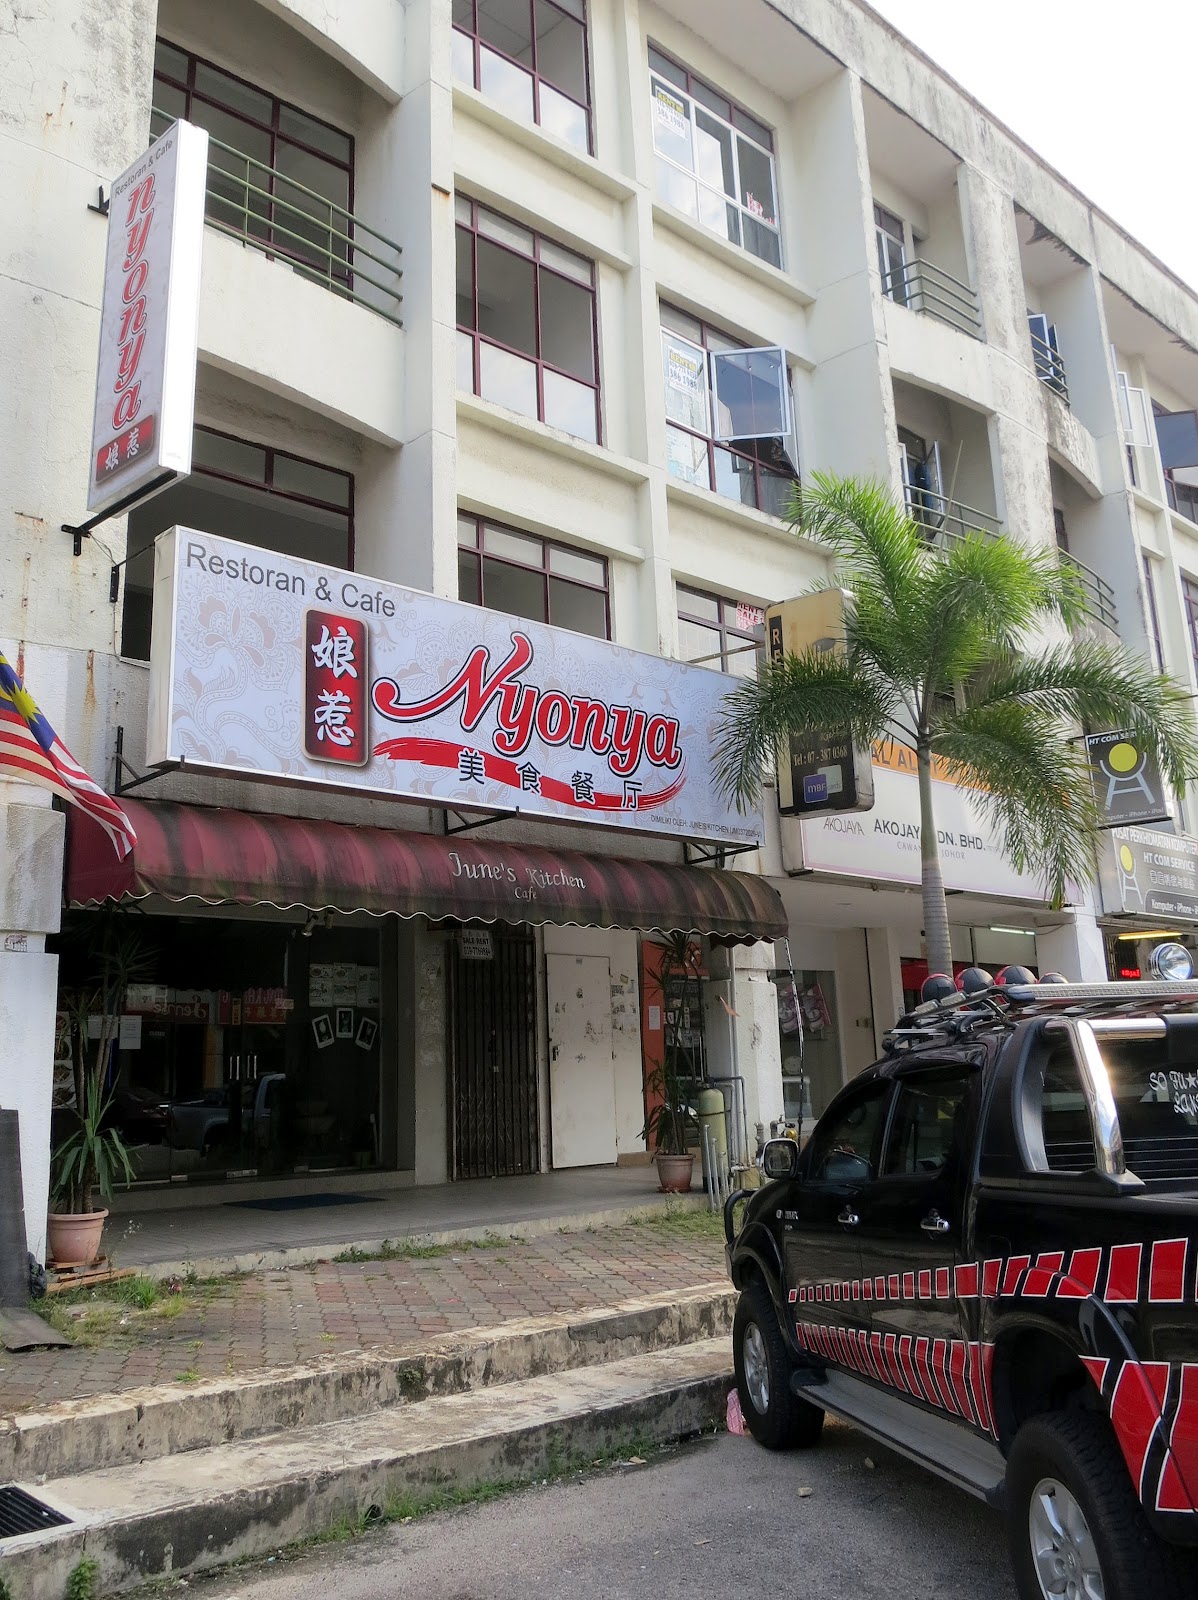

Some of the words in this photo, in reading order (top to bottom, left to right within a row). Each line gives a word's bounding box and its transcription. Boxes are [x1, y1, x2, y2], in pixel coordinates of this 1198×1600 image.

[115, 164, 147, 198] Restoran
[148, 156, 154, 167] &
[155, 140, 173, 160] Cafe
[112, 172, 156, 431] nyonya
[186, 542, 306, 597] Restoran
[314, 576, 332, 602] &
[340, 583, 397, 618] Cafe
[311, 625, 358, 746] 娘惹
[371, 631, 684, 776] Nyonya
[1101, 733, 1119, 743] COM
[458, 748, 645, 811] 美食餐厅
[707, 824, 729, 833] KITCHEN
[823, 817, 865, 836] AKOJAYA
[873, 818, 921, 840] AKOJAY
[936, 830, 958, 847] DN.
[960, 834, 987, 851] BHD.
[1111, 827, 1130, 840] PUSAT
[448, 852, 517, 883] June's
[525, 867, 587, 889] Kitchen
[1143, 851, 1153, 863] HT
[1153, 853, 1170, 867] COM
[1170, 857, 1196, 872] SERVICE
[514, 886, 538, 902] Cafe
